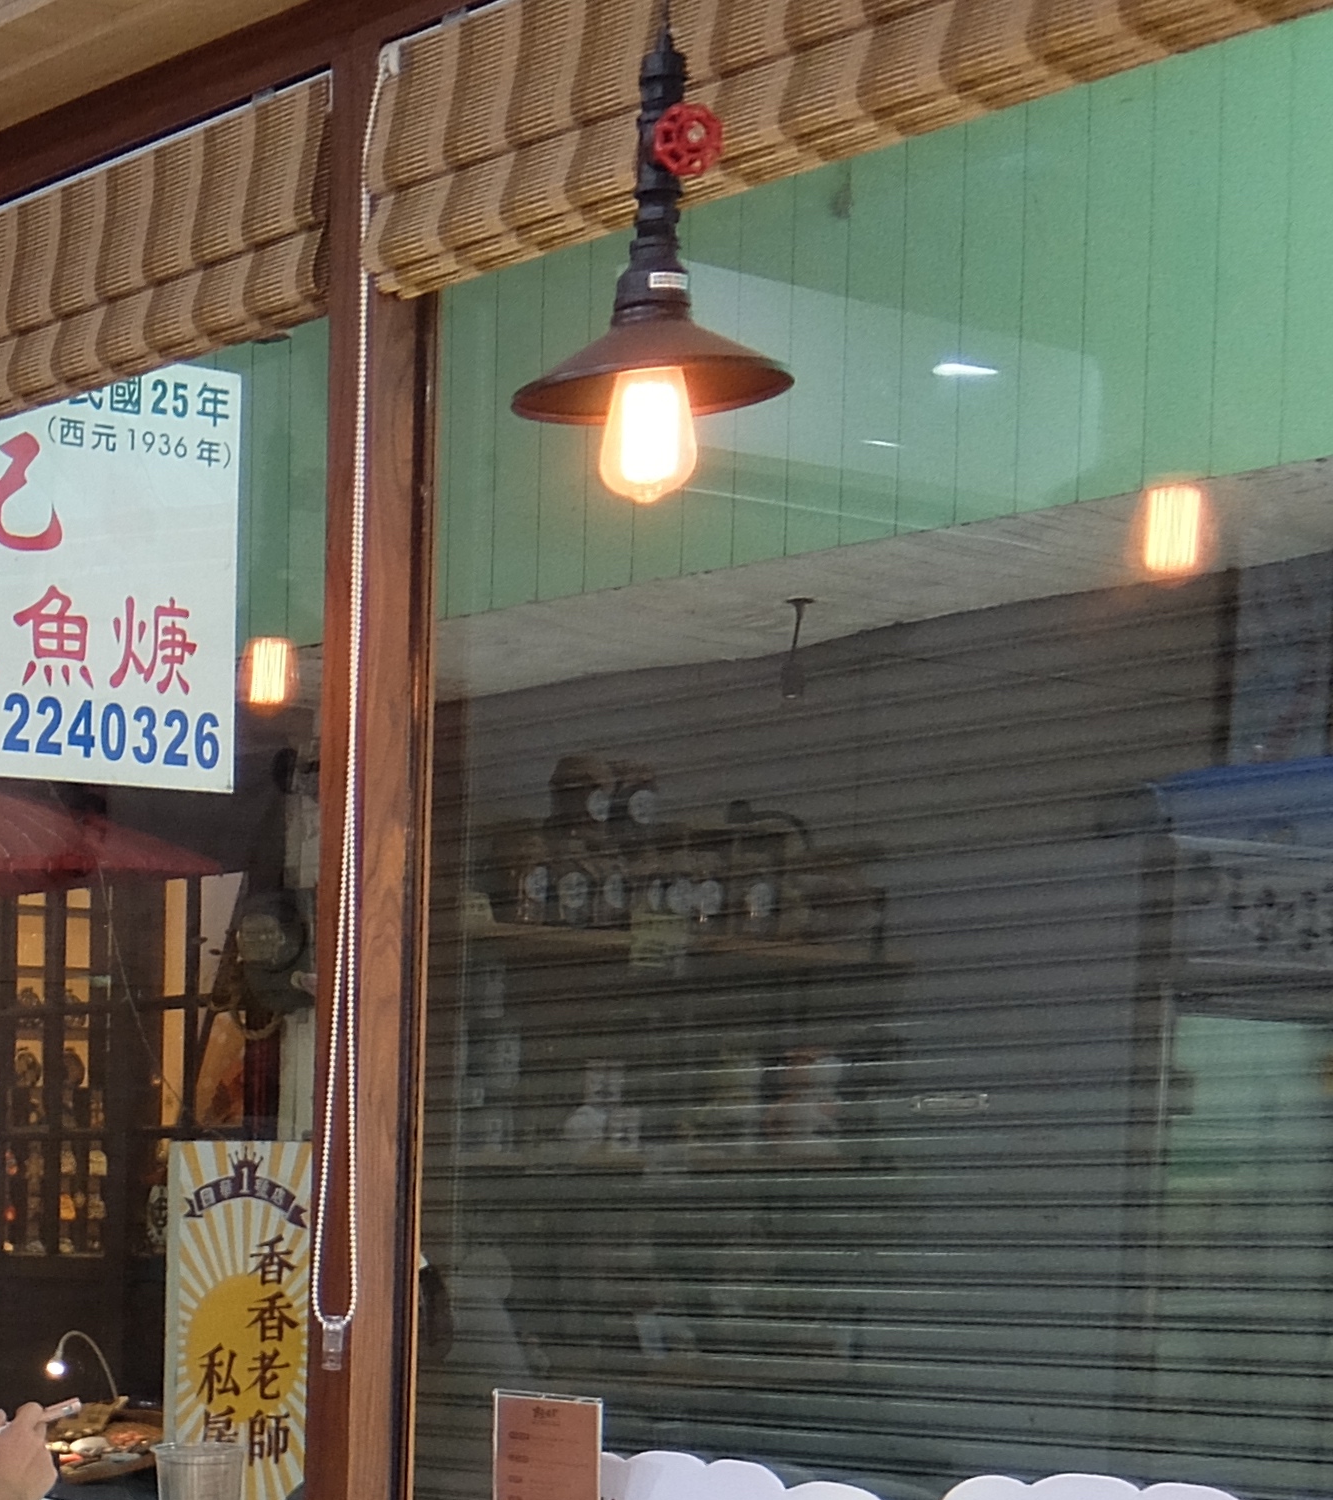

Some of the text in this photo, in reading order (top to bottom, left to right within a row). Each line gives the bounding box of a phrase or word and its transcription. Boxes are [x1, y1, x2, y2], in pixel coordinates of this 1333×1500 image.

[47, 416, 232, 469] (西元1936年)
[245, 1234, 301, 1467] 香香老師
